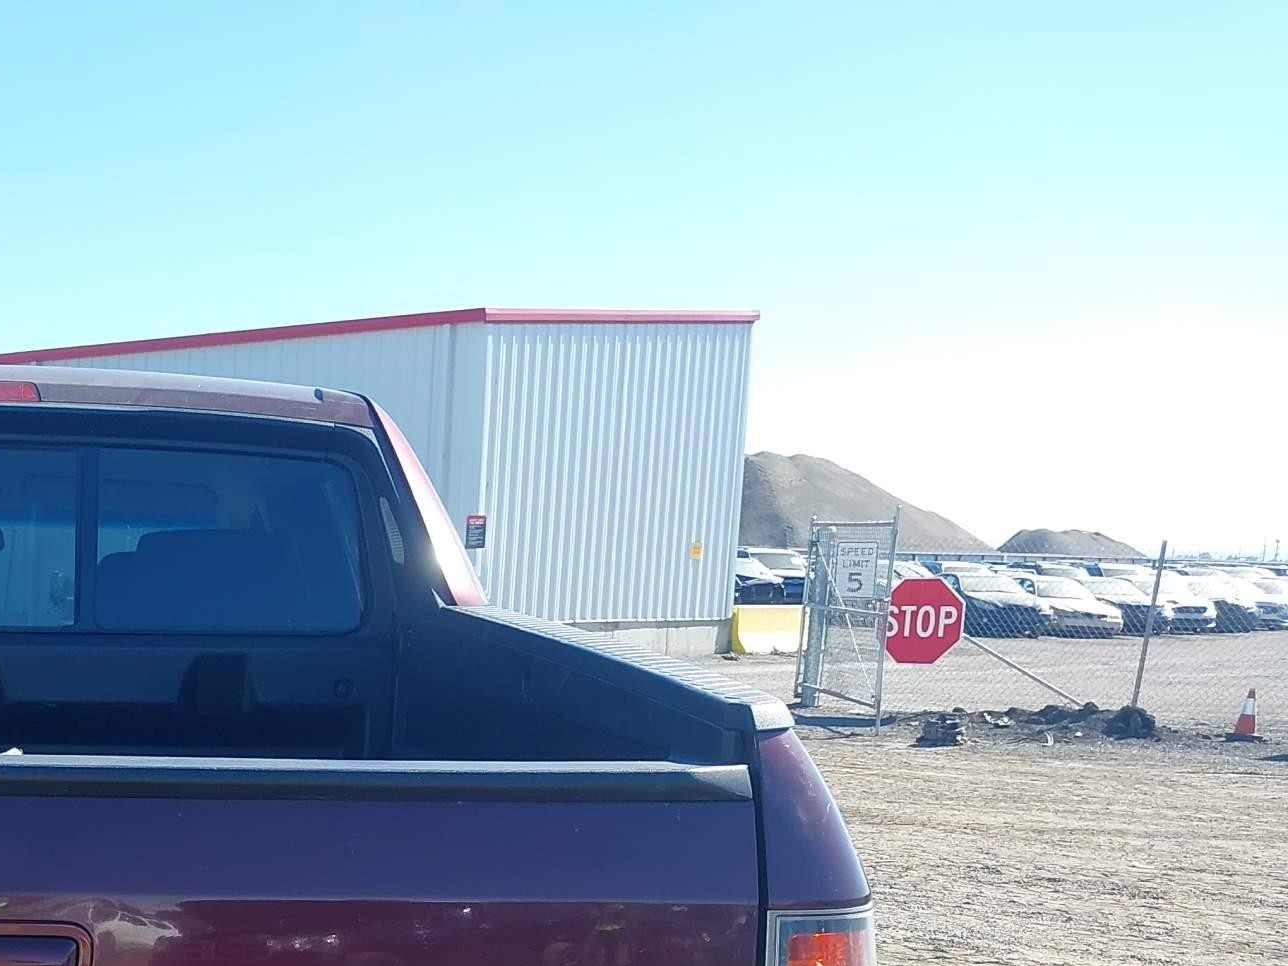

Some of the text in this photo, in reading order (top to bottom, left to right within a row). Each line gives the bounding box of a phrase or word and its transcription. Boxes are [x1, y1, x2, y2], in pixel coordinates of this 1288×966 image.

[840, 547, 874, 556] SPEED
[842, 559, 870, 568] LIMIT
[846, 572, 863, 592] 5
[887, 605, 958, 638] STOP
